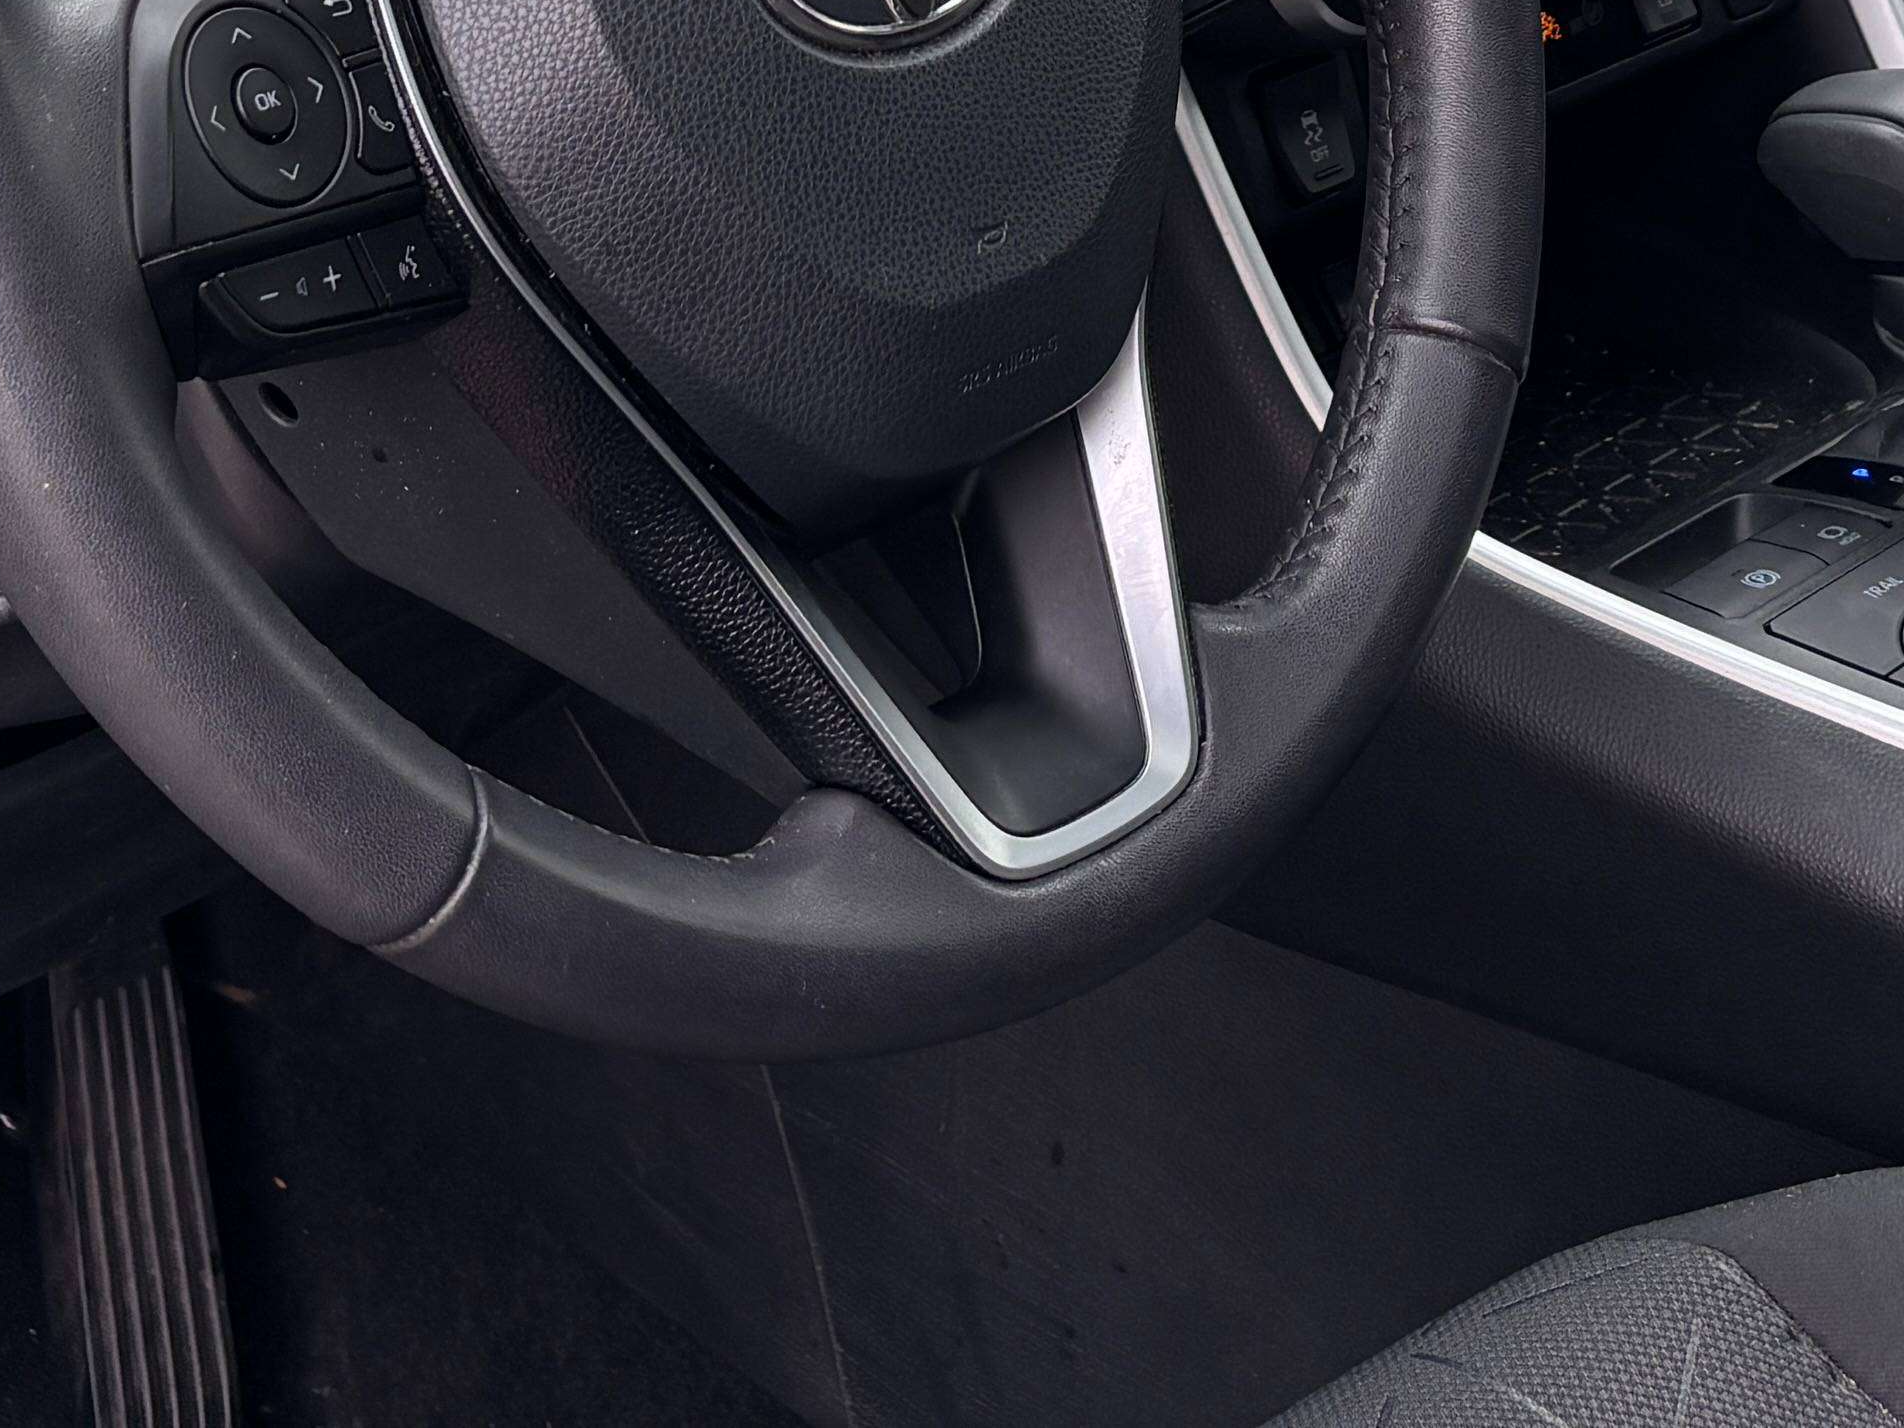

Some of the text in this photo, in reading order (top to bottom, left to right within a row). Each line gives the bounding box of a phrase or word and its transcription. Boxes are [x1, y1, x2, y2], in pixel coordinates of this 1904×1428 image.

[254, 90, 281, 111] OK
[1310, 145, 1330, 163] OFF
[1863, 575, 1904, 599] TRAIL
